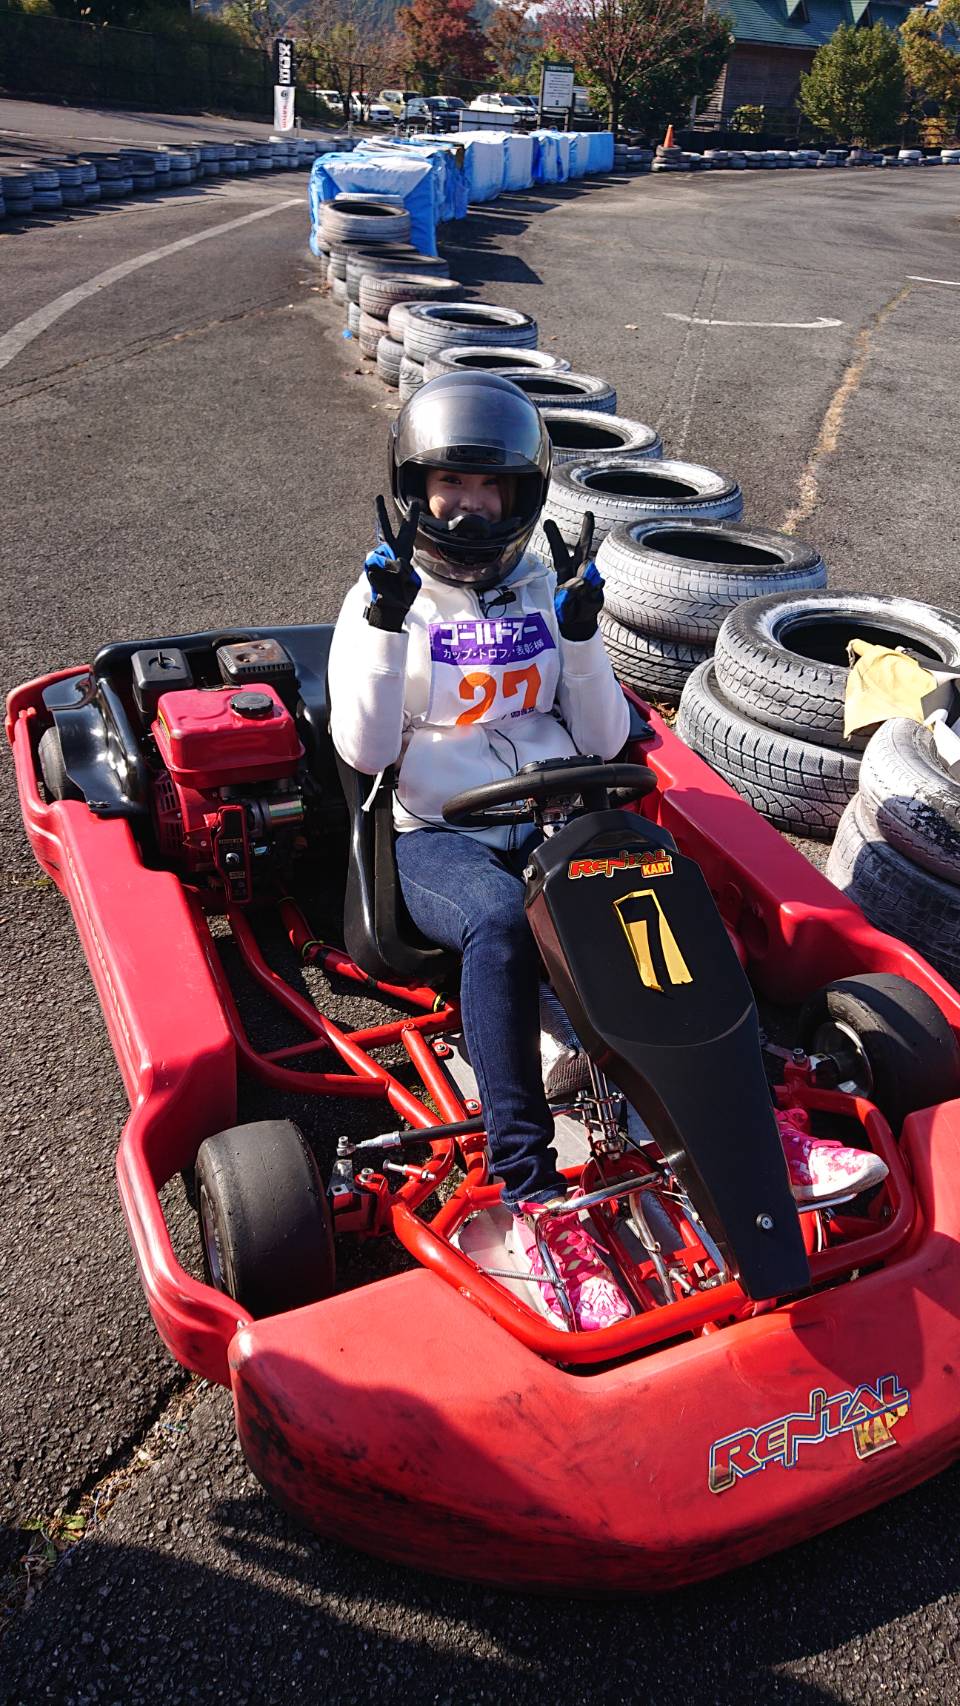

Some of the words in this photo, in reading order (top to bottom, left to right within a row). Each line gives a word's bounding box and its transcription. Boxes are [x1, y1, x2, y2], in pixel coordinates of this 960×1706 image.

[456, 663, 541, 725] 27
[568, 850, 671, 879] RENTAL
[642, 862, 672, 877] KART
[614, 889, 688, 993] 7
[710, 1374, 909, 1493] RENTAL
